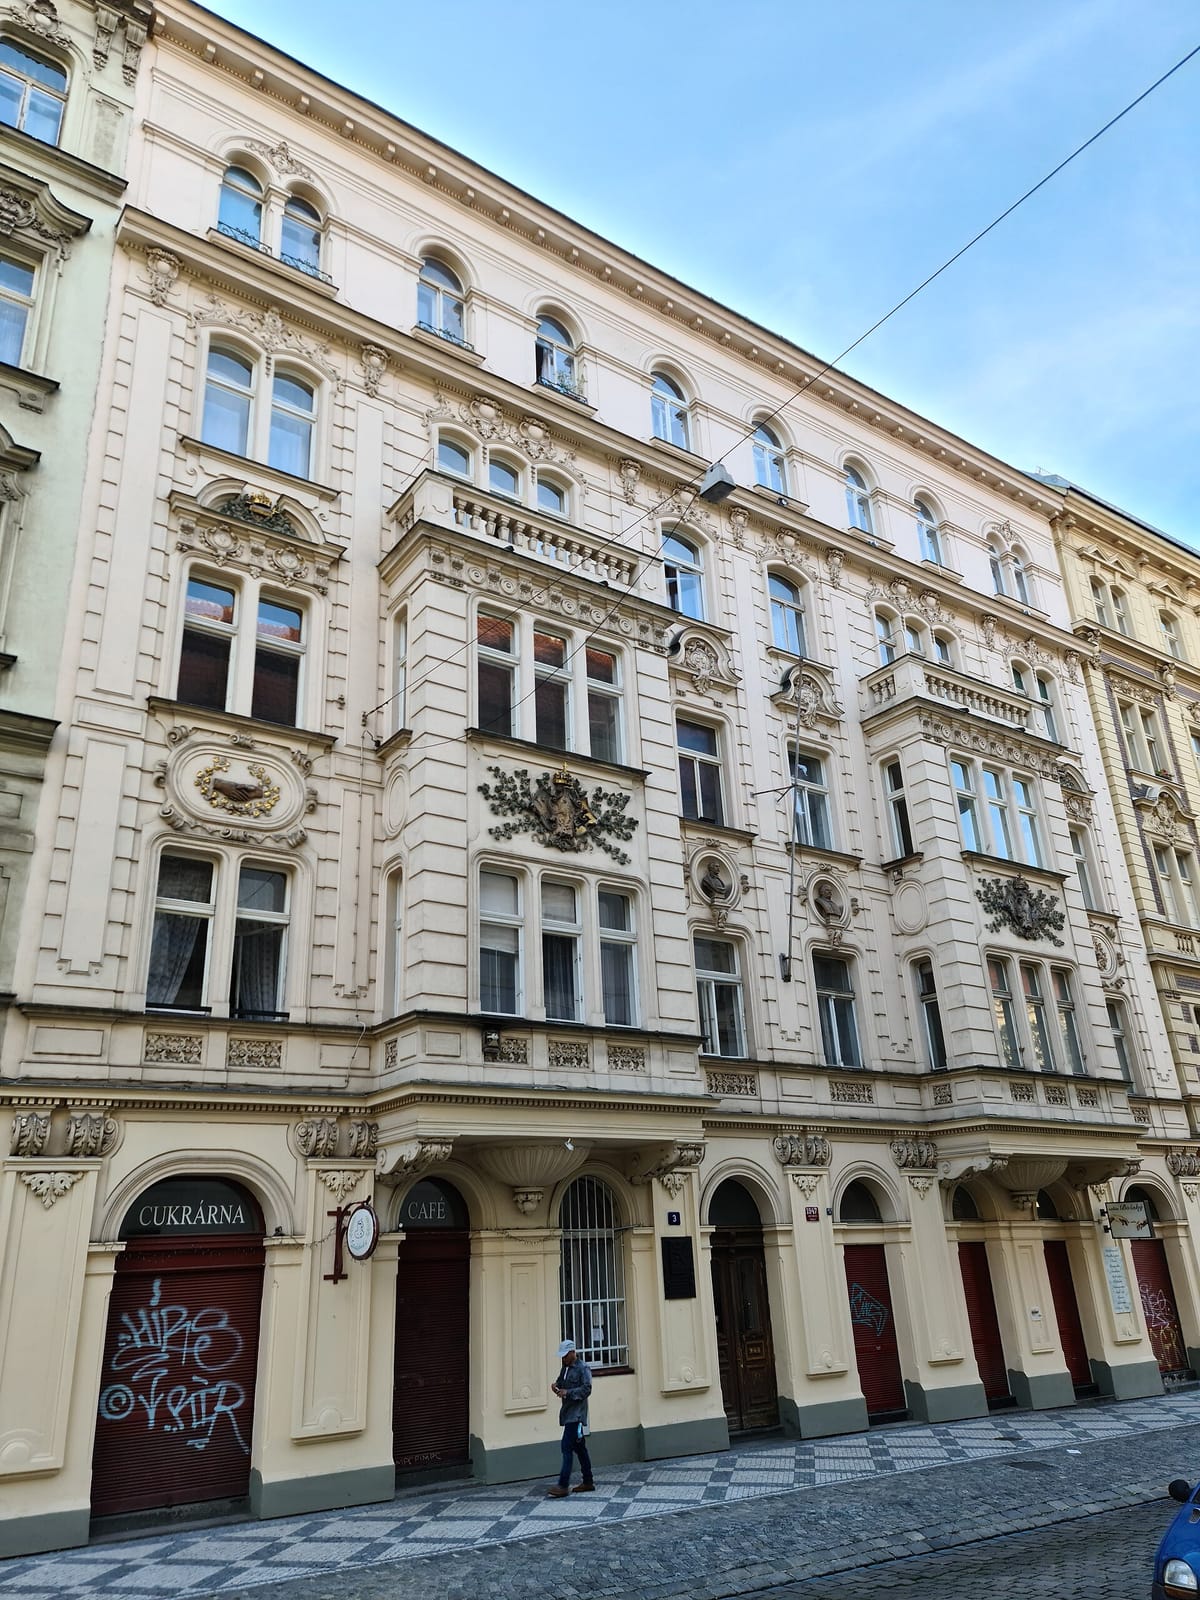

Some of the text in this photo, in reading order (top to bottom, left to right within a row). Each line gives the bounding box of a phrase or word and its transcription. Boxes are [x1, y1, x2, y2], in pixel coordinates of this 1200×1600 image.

[139, 1199, 246, 1226] CUKRÁRNA
[408, 1196, 446, 1220] CAFÉ
[671, 1214, 677, 1223] 3
